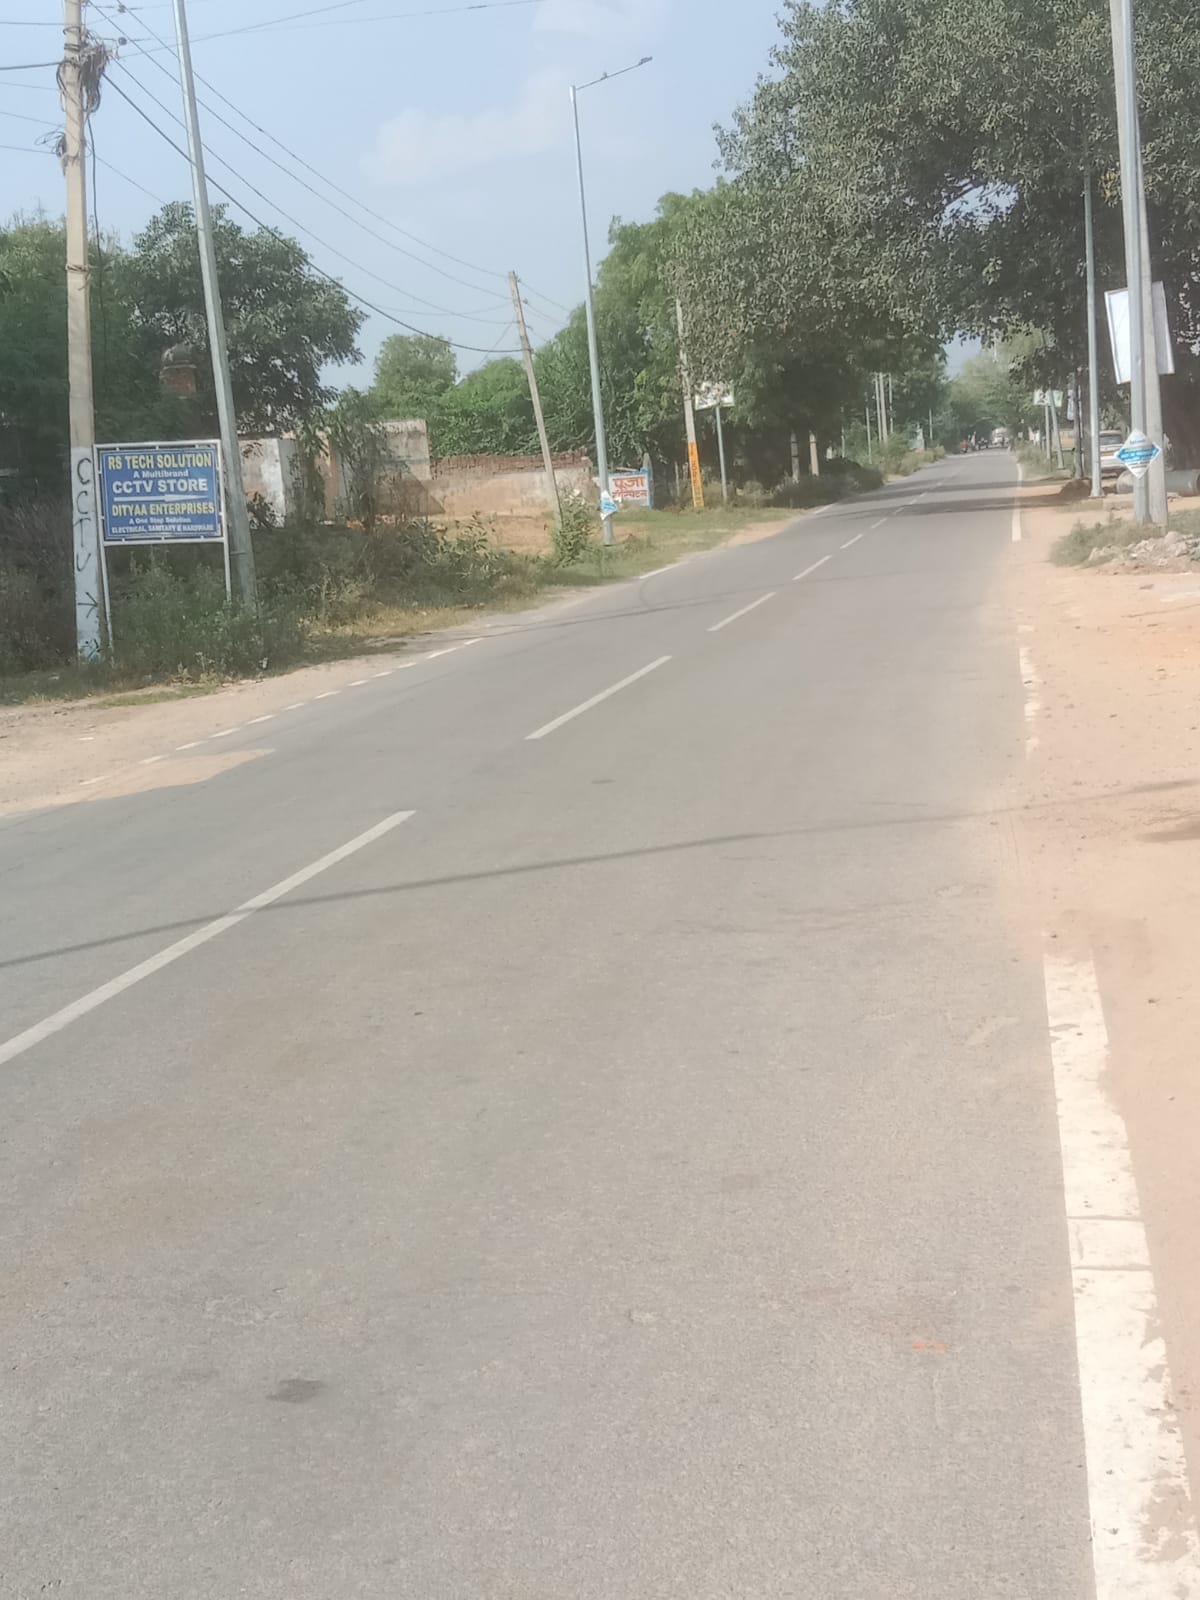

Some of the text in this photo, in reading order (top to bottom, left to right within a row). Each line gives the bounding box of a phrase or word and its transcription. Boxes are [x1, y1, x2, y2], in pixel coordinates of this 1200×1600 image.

[108, 453, 212, 470] RS TECH SOLUTION
[133, 469, 189, 479] A Multibrand
[112, 478, 208, 494] CCTV STORE
[112, 502, 215, 517] DITYAA ENTERPRISES
